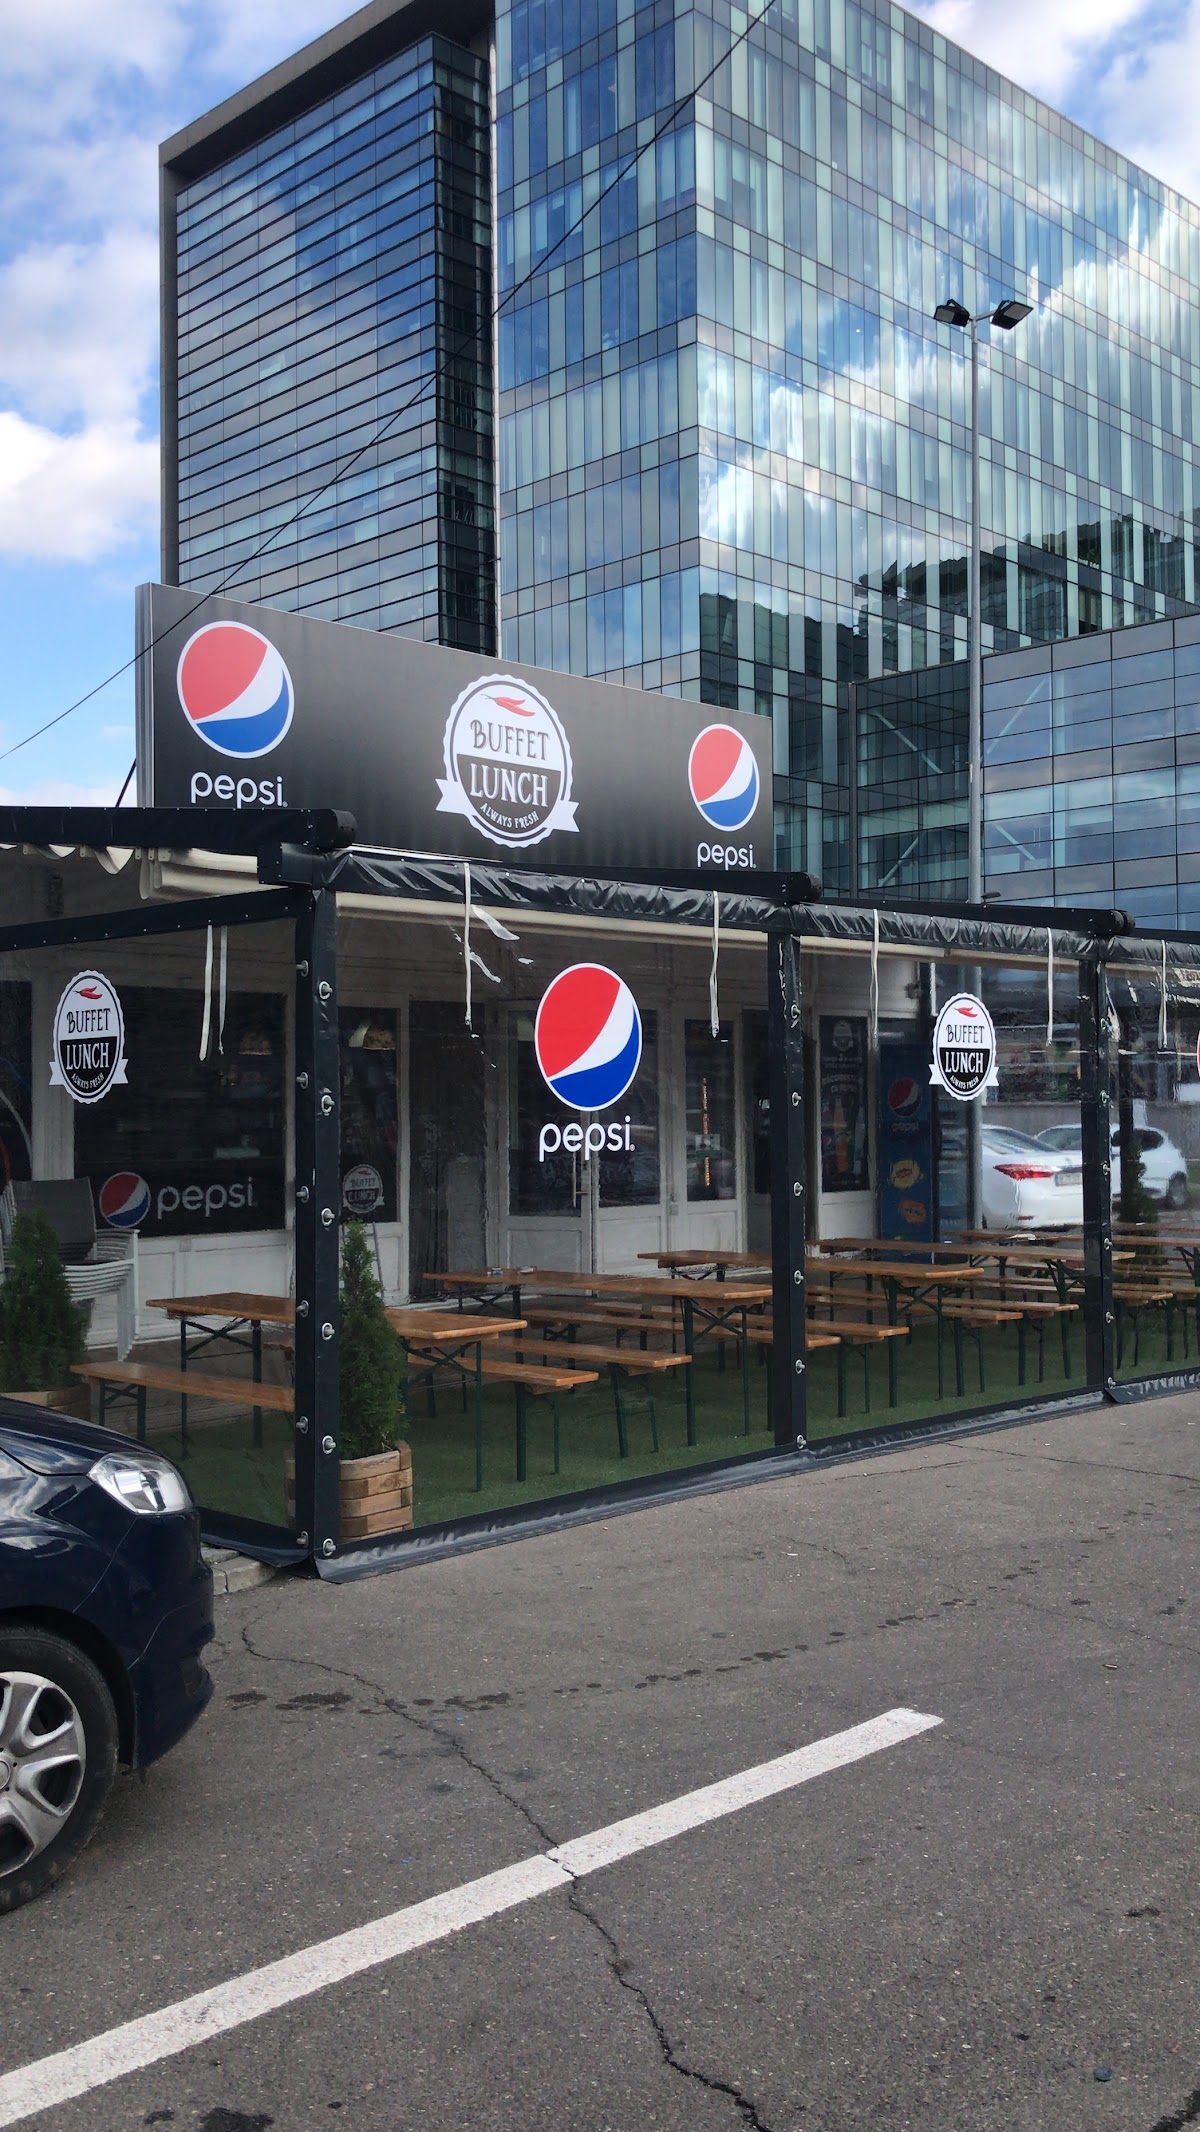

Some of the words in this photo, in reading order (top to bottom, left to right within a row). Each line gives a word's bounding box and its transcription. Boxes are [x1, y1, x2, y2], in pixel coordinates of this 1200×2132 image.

[470, 719, 549, 760] BUFFET
[190, 771, 283, 809] pepsi
[470, 763, 549, 807] LUNCH
[480, 803, 513, 828] ALWAYS
[514, 811, 540, 829] FRESH
[697, 842, 754, 871] pepsi
[66, 1008, 111, 1034] BUFFET
[946, 1024, 985, 1043] BUFFET
[66, 1042, 110, 1070] LUNCH
[945, 1051, 984, 1073] LUNCH
[71, 1073, 90, 1089] ALWAYS
[90, 1072, 105, 1088] FRESH
[539, 1115, 632, 1162] pepsi
[157, 1176, 253, 1219] pepsi
